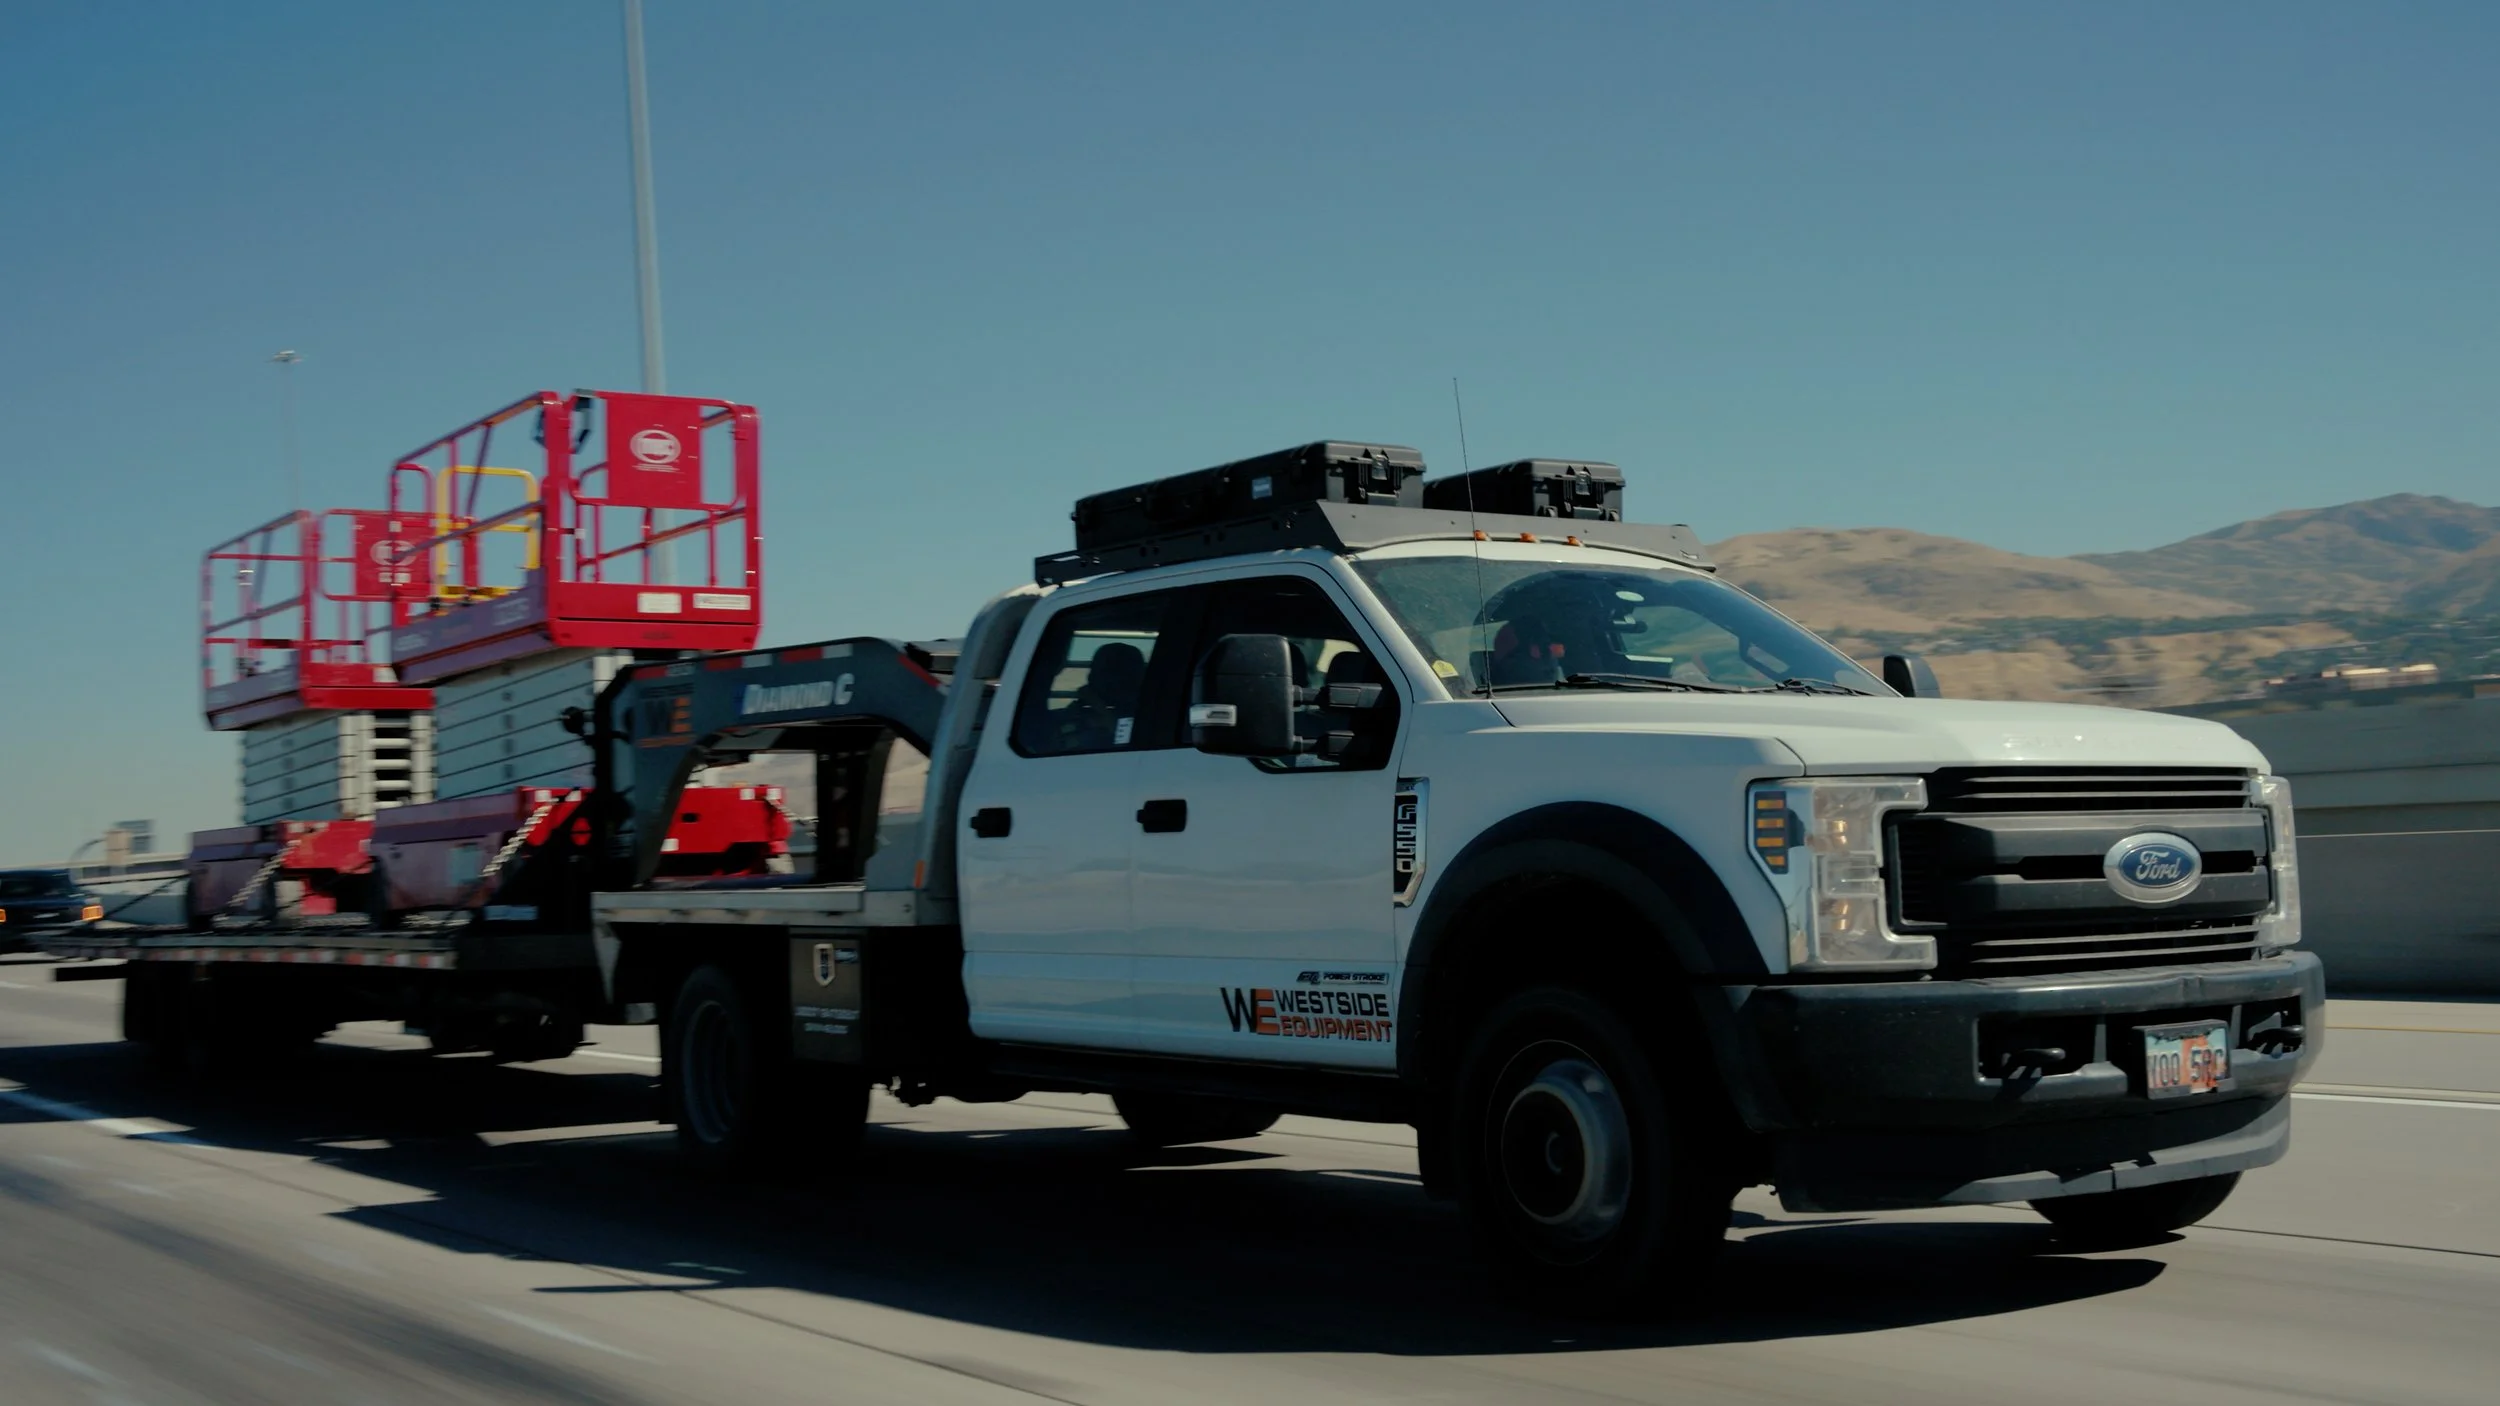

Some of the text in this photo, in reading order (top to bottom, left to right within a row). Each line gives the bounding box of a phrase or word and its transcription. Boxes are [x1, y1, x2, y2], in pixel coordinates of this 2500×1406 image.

[834, 673, 855, 705] C
[2135, 850, 2181, 880] Ford
[1219, 987, 1280, 1036] WE
[1275, 990, 1390, 1017] WESTSIDE
[1280, 1016, 1393, 1042] EQUIPMENT
